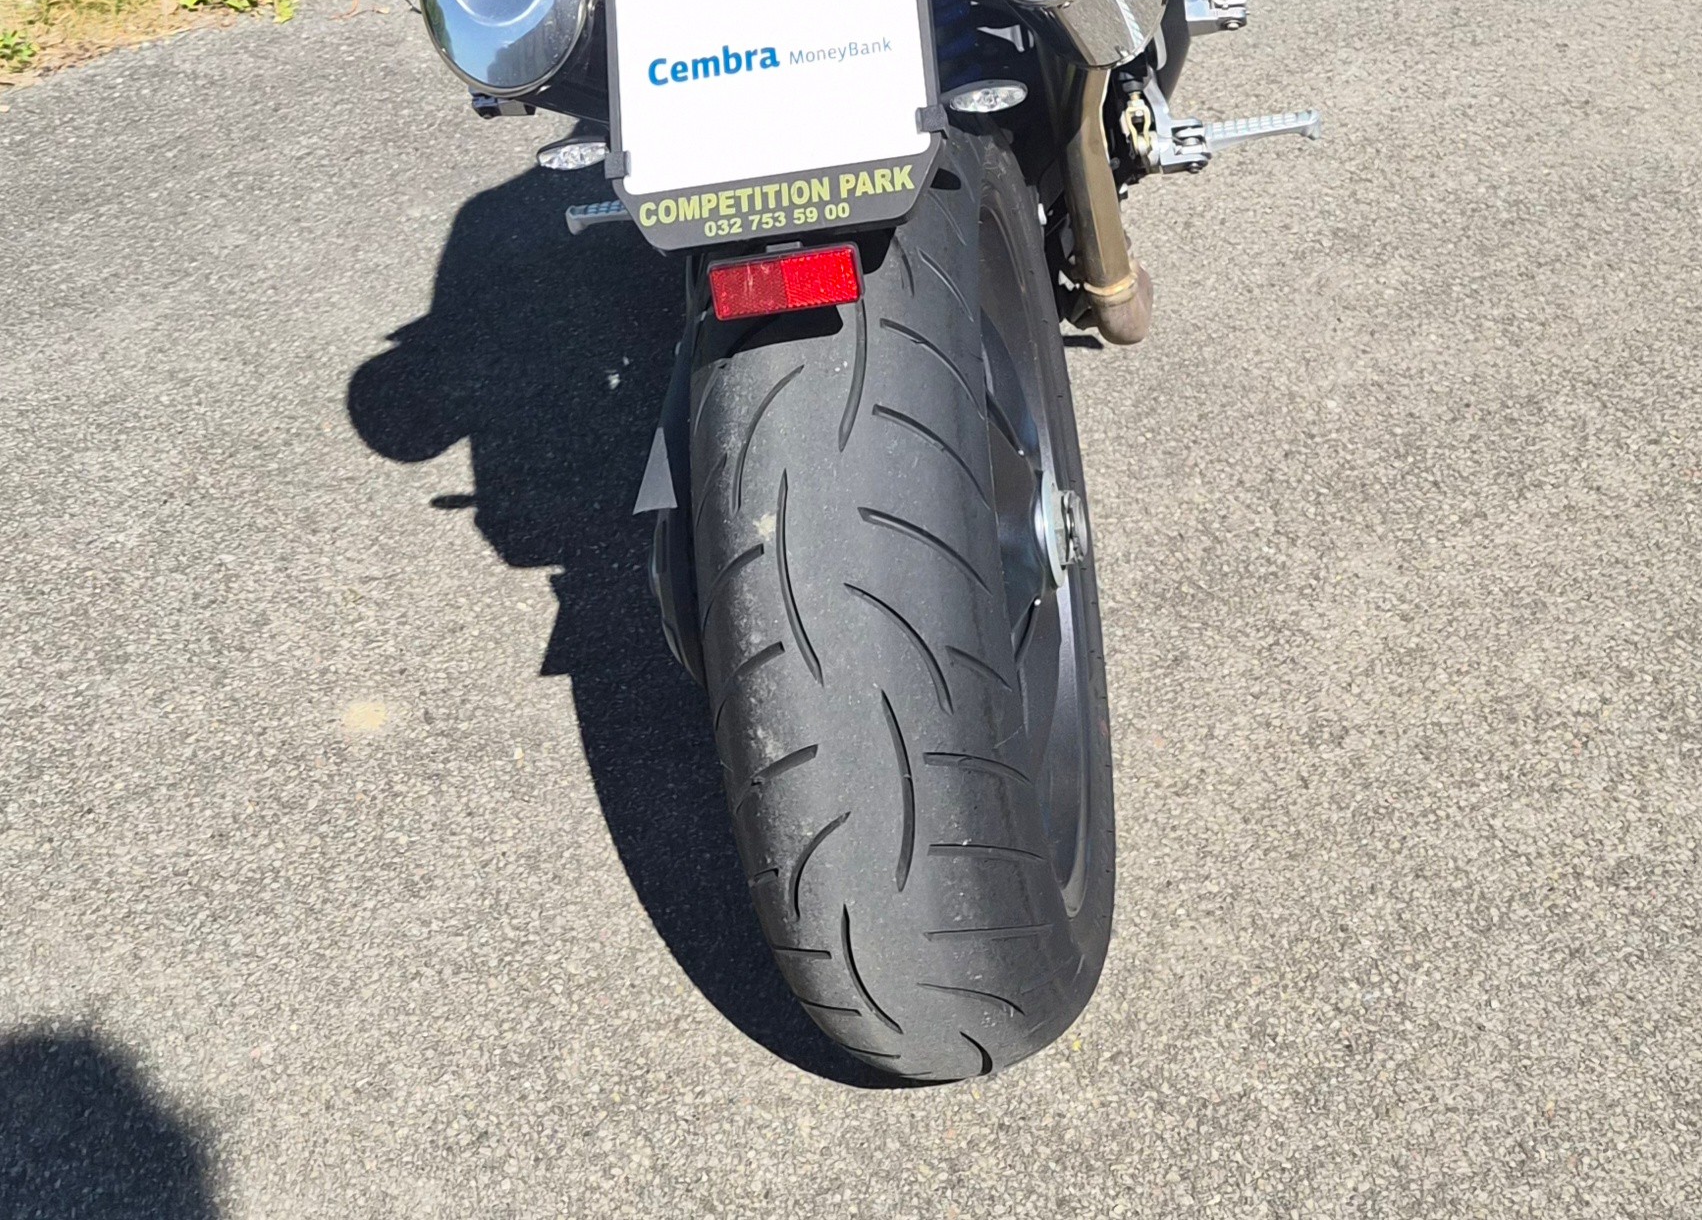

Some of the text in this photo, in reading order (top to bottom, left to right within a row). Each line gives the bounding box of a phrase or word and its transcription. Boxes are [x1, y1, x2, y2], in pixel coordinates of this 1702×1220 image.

[649, 37, 892, 86] Cembra MoneyBank
[639, 165, 914, 227] COMPETITION PARK
[704, 202, 850, 237] 032 753 59 00
